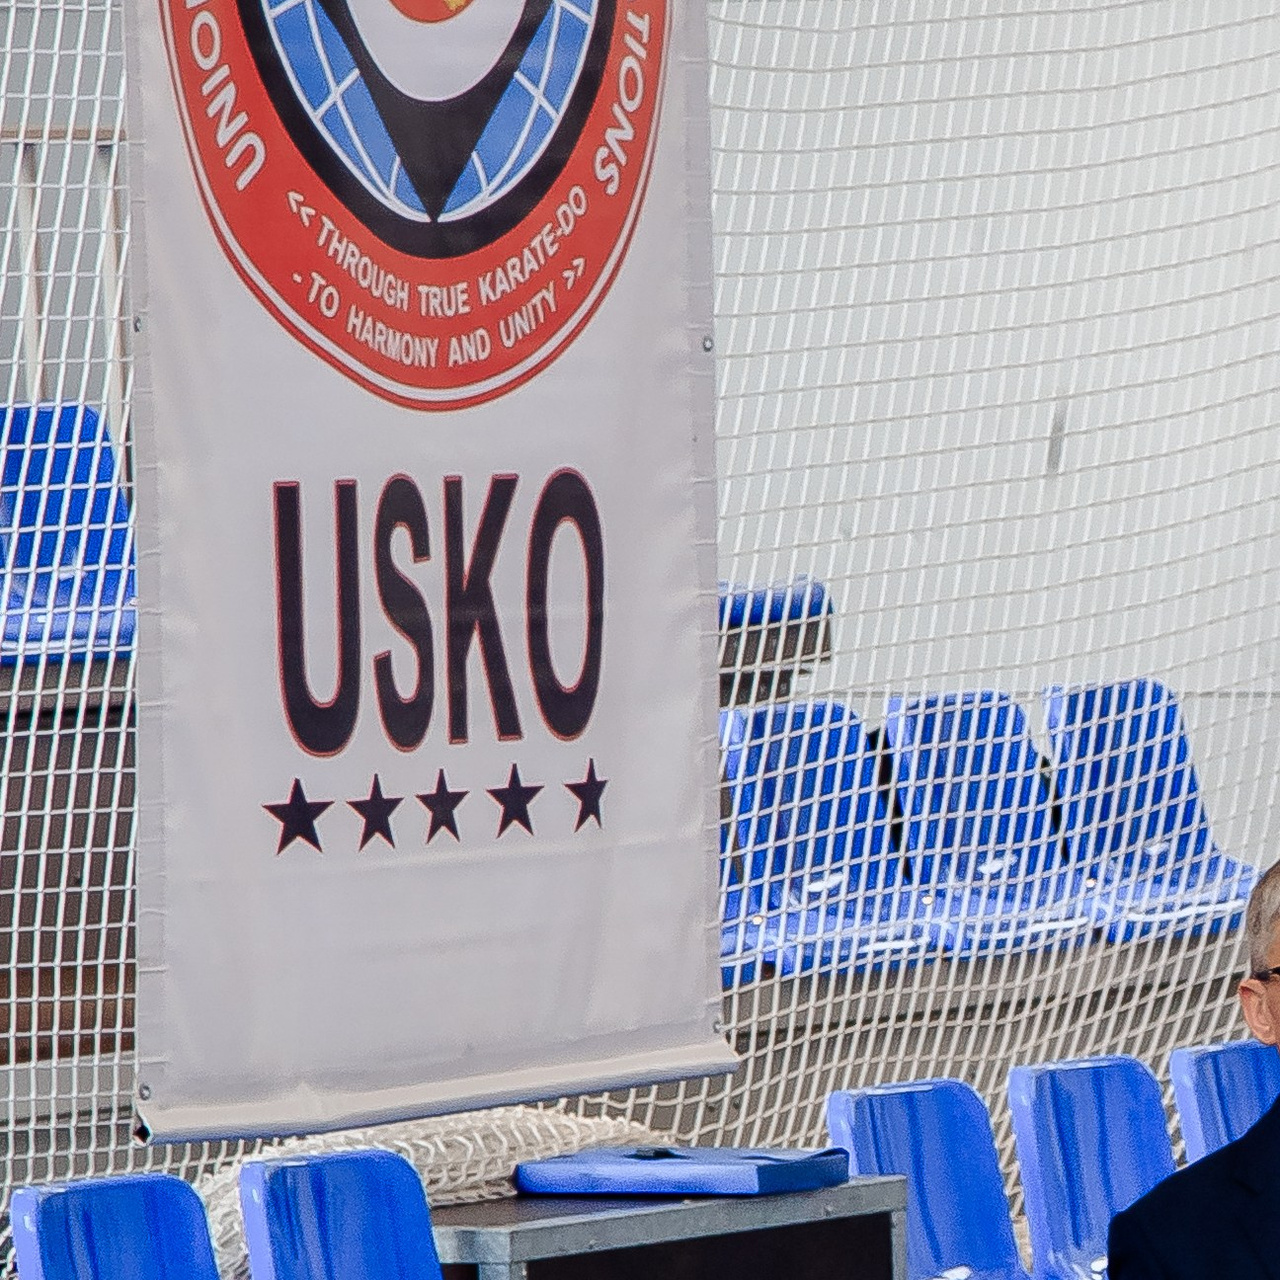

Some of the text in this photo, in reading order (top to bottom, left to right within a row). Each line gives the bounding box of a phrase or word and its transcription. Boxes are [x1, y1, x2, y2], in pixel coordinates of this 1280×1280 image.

[417, 284, 469, 317] TRUE
[478, 185, 588, 306] KARATE-DO
[308, 271, 339, 317] TO
[347, 304, 438, 367] HARMONY
[448, 328, 490, 367] AND
[501, 287, 556, 348] UNITY
[273, 466, 605, 759] USKO
